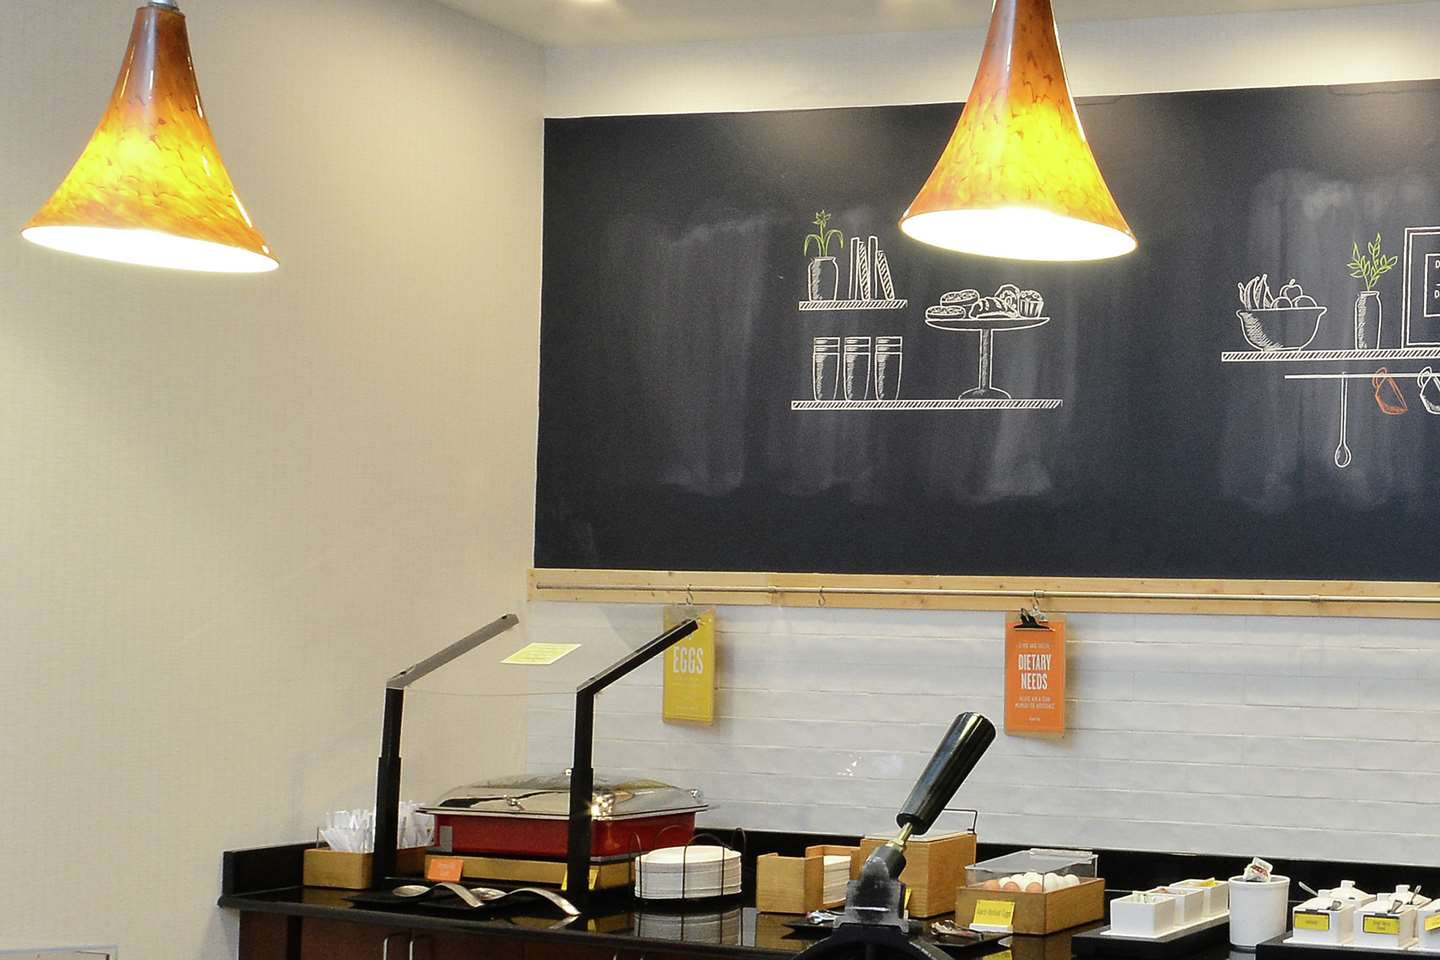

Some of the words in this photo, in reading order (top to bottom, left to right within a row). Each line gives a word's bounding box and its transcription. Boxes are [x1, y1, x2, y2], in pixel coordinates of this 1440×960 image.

[672, 646, 704, 674] EGGS
[1018, 653, 1052, 671] DIETARY
[1021, 672, 1048, 690] NEEDS
